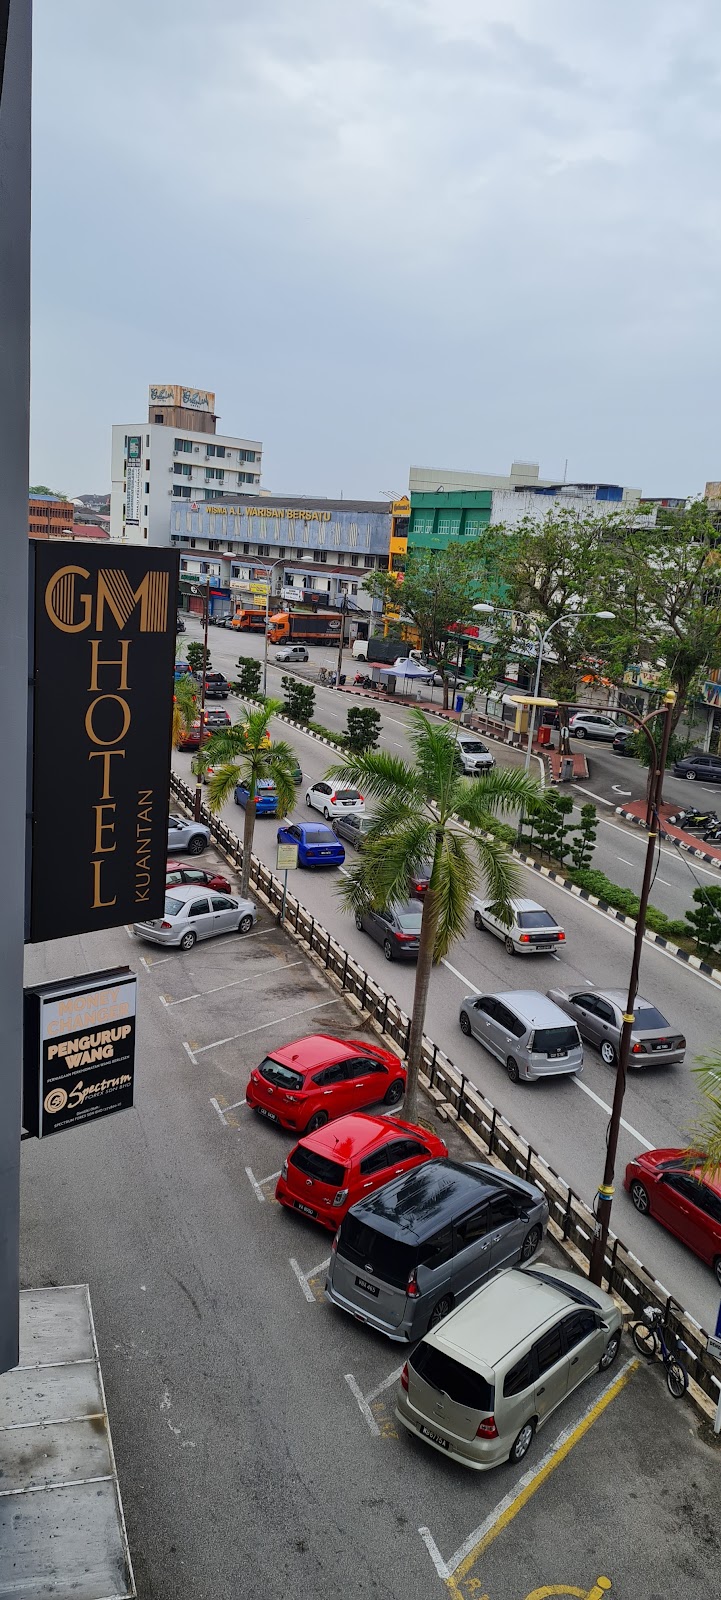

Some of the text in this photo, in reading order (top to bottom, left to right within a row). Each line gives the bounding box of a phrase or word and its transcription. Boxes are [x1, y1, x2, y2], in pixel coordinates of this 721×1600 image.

[205, 506, 228, 514] WISMA
[245, 507, 285, 518] WARISAN
[286, 509, 332, 521] BERSATU
[44, 564, 169, 634] GM
[85, 639, 132, 909] HOTEL
[135, 789, 153, 902] KUANTAN
[58, 987, 120, 1016] MONEY
[47, 1002, 129, 1036] CHANGER
[47, 1024, 132, 1061] PENGURUP
[64, 1044, 114, 1070] WANG
[67, 1074, 132, 1109] Spectrum
[85, 1082, 131, 1101] FOREX SDN BHD
[53, 1117, 75, 1129] SPECTRUM
[75, 1114, 87, 1122] FOREX
